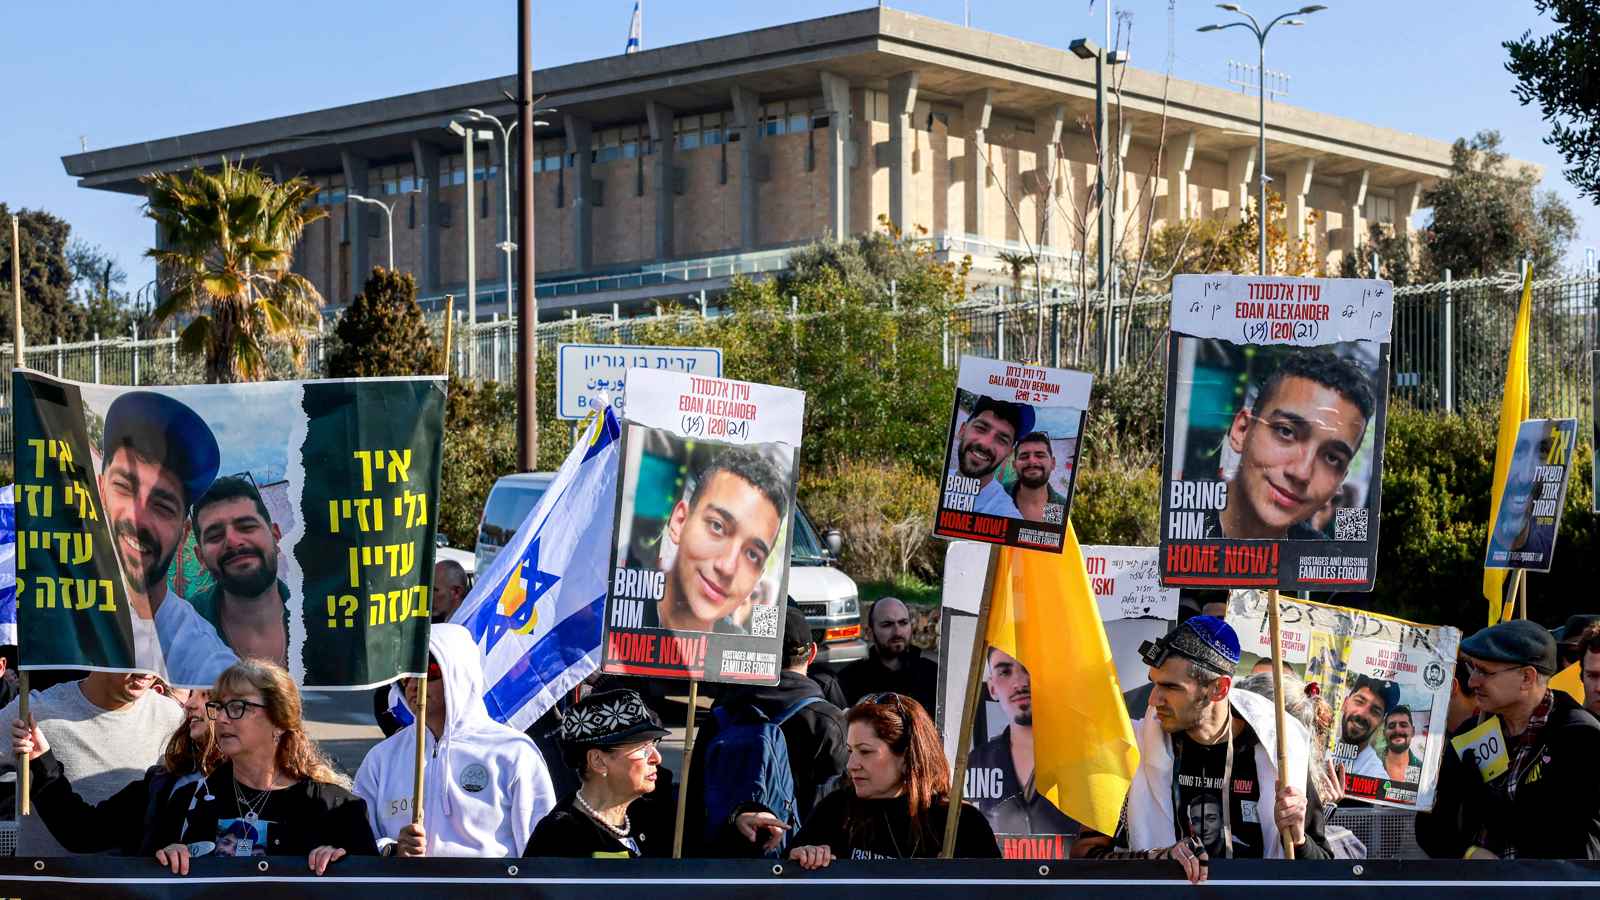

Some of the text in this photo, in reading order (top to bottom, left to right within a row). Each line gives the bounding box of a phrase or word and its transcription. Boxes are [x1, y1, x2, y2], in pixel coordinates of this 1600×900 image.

[1248, 283, 1320, 302] עידן אלכסנדר
[1235, 302, 1329, 320] EDAN ALEXANDER
[1271, 322, 1292, 340] (20)
[1293, 320, 1319, 341] (21)
[585, 354, 625, 369] גוריון
[656, 357, 696, 373] קרית
[690, 377, 750, 401] עידן אלכסנדר
[988, 374, 1060, 394] GALI AND ZIV BERMAN
[680, 395, 757, 420] EDAN ALEXANDER
[708, 417, 726, 437] (20)
[28, 439, 76, 478] איך
[354, 449, 412, 491] איך
[945, 475, 981, 494] BRING
[1169, 480, 1228, 510] BRING
[1542, 482, 1560, 499] אותי
[65, 480, 99, 521] גלי
[329, 490, 428, 533] גלי וזיו
[942, 492, 975, 512] THEM
[1532, 500, 1556, 517] מאחור
[940, 511, 1009, 536] HOME NOW!
[1168, 511, 1204, 539] HIM
[17, 531, 93, 570] עדיין
[1018, 533, 1060, 547] FAMILIES FORUM
[349, 541, 415, 587] עדיין
[1166, 543, 1220, 575] HOME
[1223, 543, 1280, 575] NOW!
[1299, 556, 1369, 567] HOSTAGES AND MISSING
[613, 568, 665, 600] BRING
[1299, 565, 1368, 581] FAMILIES FORUM
[36, 576, 117, 612] בעזה
[369, 585, 429, 626] בעזה
[611, 598, 644, 629] HIM
[607, 631, 709, 667] HOME NOW!
[720, 659, 776, 676] FAMILIES FORUM
[1365, 656, 1377, 665] GALI
[1234, 780, 1252, 791] NOW
